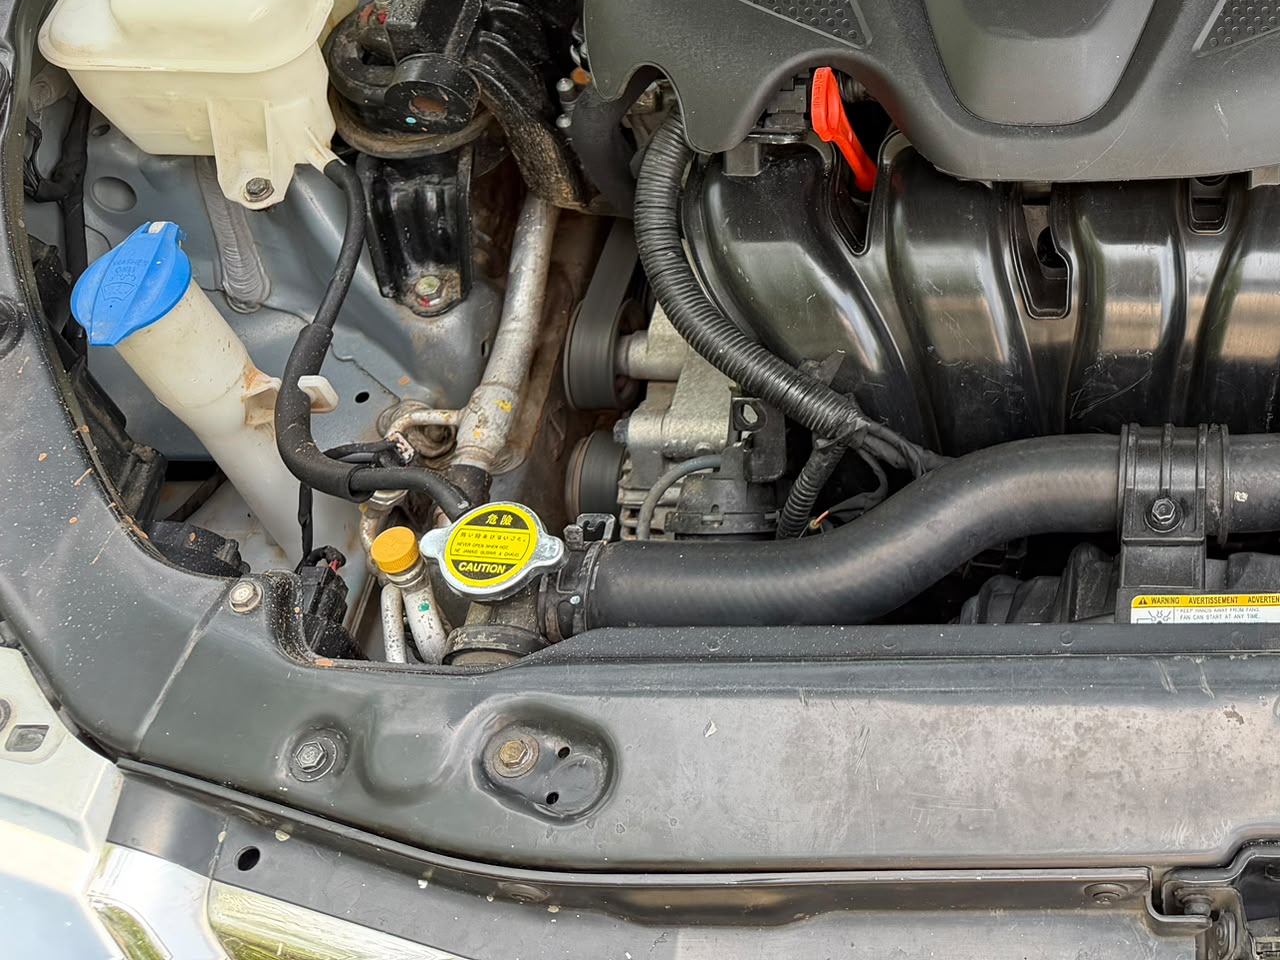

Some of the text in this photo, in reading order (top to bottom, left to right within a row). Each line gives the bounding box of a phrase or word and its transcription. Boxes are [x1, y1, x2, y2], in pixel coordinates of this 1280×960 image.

[458, 561, 507, 574] CAUTION
[1151, 597, 1180, 605] WARNING
[1188, 596, 1238, 605] AVERTISSEMENT
